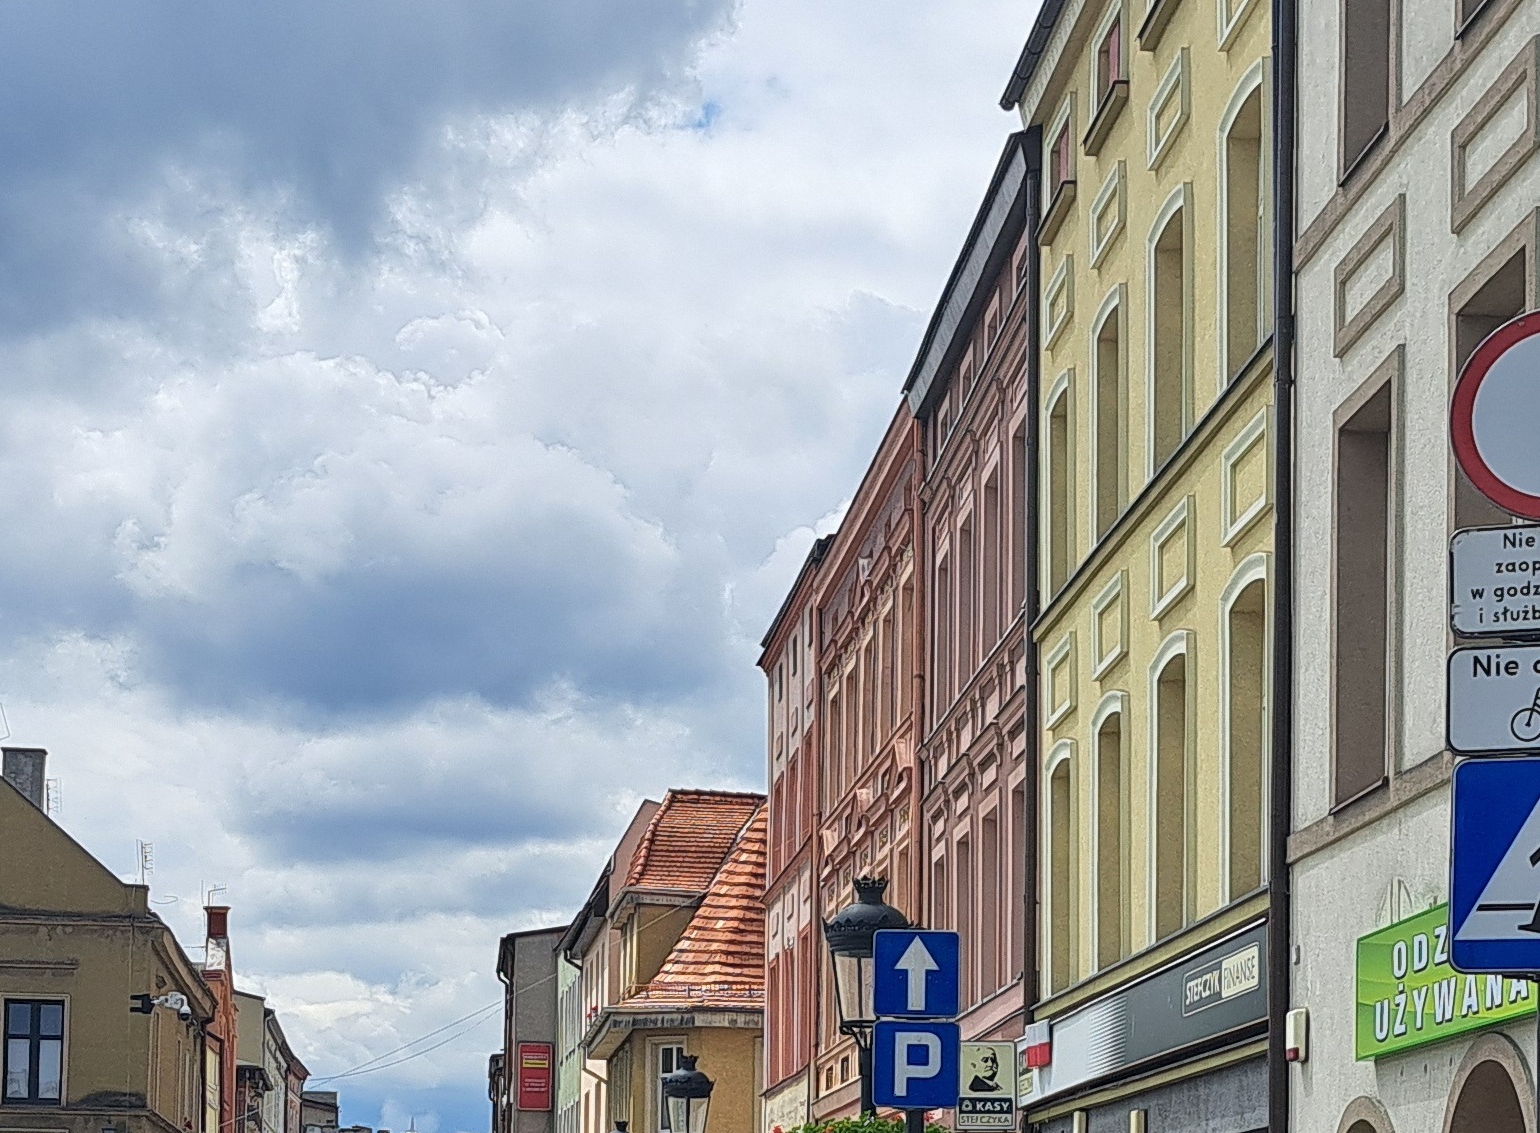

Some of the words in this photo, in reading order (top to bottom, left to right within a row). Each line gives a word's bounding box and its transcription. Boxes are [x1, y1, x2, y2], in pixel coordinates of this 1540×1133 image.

[1503, 532, 1536, 549] Nie
[1471, 587, 1485, 600] w
[1479, 607, 1484, 624] i
[1472, 654, 1520, 678] Nie
[1391, 924, 1450, 979] ODZ
[1185, 969, 1221, 1006] STEFCZYK
[1374, 974, 1530, 1043] UŻYWANA
[893, 1031, 942, 1098] P
[975, 1100, 1011, 1112] KASY
[960, 1114, 1011, 1125] STEFCZYKA
